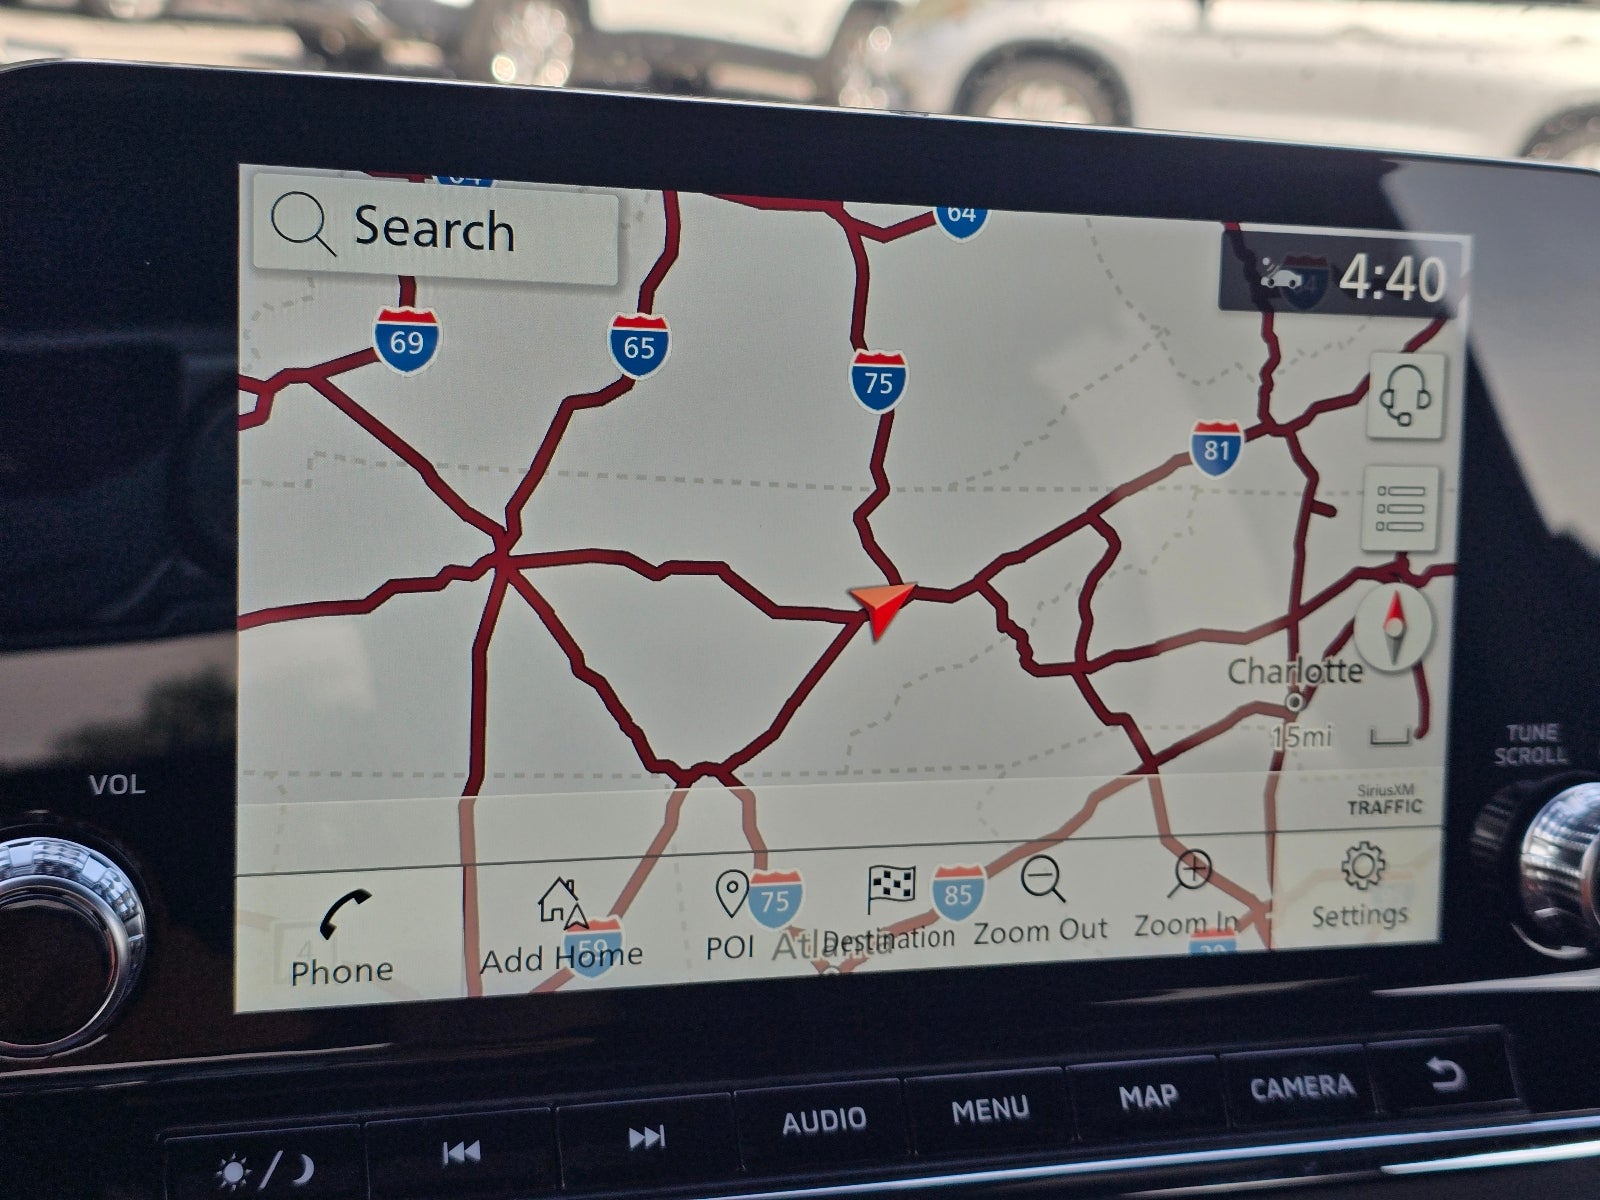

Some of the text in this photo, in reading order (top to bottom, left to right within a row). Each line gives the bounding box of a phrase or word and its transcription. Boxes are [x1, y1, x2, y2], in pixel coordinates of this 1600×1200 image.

[947, 206, 976, 222] 64
[355, 204, 515, 252] Search
[1339, 252, 1446, 303] 4:40
[390, 331, 424, 354] 69
[624, 336, 655, 360] 65
[864, 372, 893, 394] 75
[1204, 440, 1229, 461] 81
[1228, 656, 1364, 684] Charlotte
[1272, 724, 1332, 748] 15mi
[1506, 723, 1559, 741] TUNE
[1494, 746, 1568, 766] SCROLL
[88, 773, 146, 795] VOL
[1357, 783, 1415, 797] SiriusXM
[1347, 799, 1423, 815] TRAFFIC
[760, 890, 789, 913] 75
[944, 884, 973, 906] 85
[1134, 910, 1239, 937] Zoom In
[1312, 903, 1408, 930] Settings
[823, 925, 955, 953] Destination
[973, 916, 1108, 945] Zoom Out
[479, 945, 643, 975] Add Home
[707, 933, 754, 961] POI
[292, 958, 394, 987] Phone
[1119, 1083, 1179, 1111] MAP
[1250, 1073, 1358, 1103] CAMERA
[782, 1106, 867, 1136] AUDIO
[952, 1094, 1030, 1126] MENU
